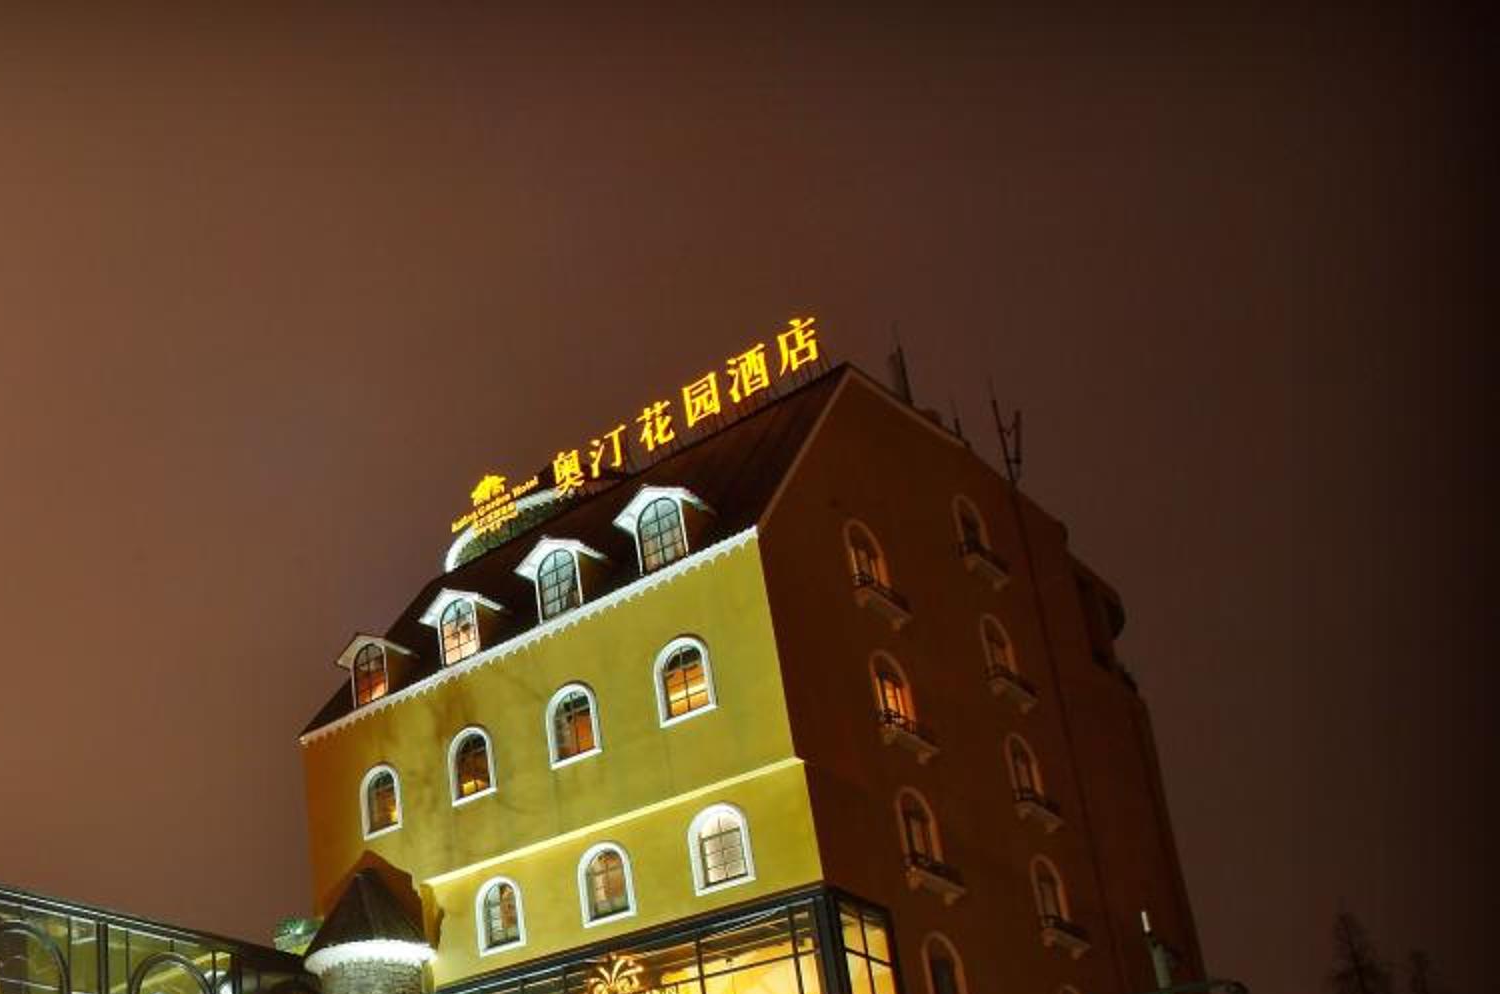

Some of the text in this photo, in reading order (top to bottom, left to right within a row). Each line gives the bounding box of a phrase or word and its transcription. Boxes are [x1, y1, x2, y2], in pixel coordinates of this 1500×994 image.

[552, 316, 820, 500] 奥汀花园酒店
